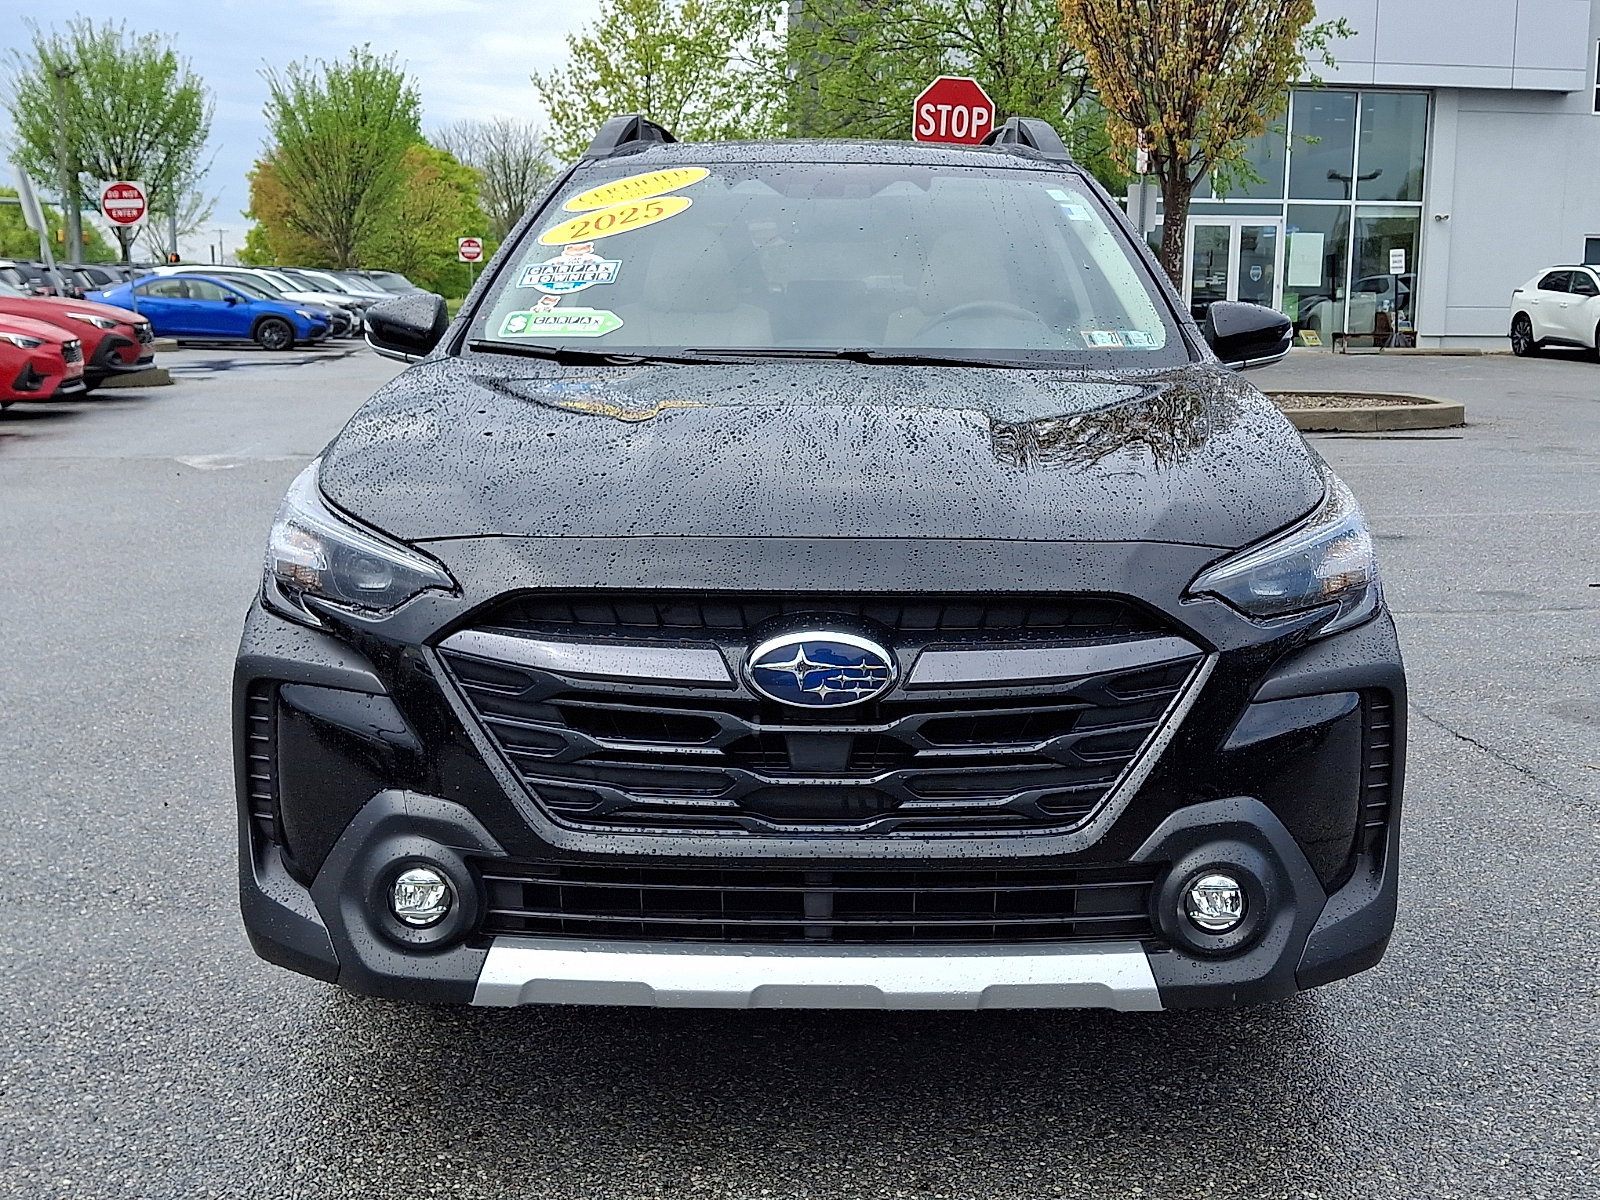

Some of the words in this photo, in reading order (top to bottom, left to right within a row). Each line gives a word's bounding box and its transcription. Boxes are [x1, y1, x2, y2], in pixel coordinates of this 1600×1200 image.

[918, 103, 989, 138] STOP
[107, 190, 119, 198] DO
[122, 190, 138, 198] NOT
[112, 209, 137, 217] ENTER
[570, 201, 664, 239] 2025
[528, 264, 611, 275] CARFAX
[533, 316, 600, 325] CARFAX
